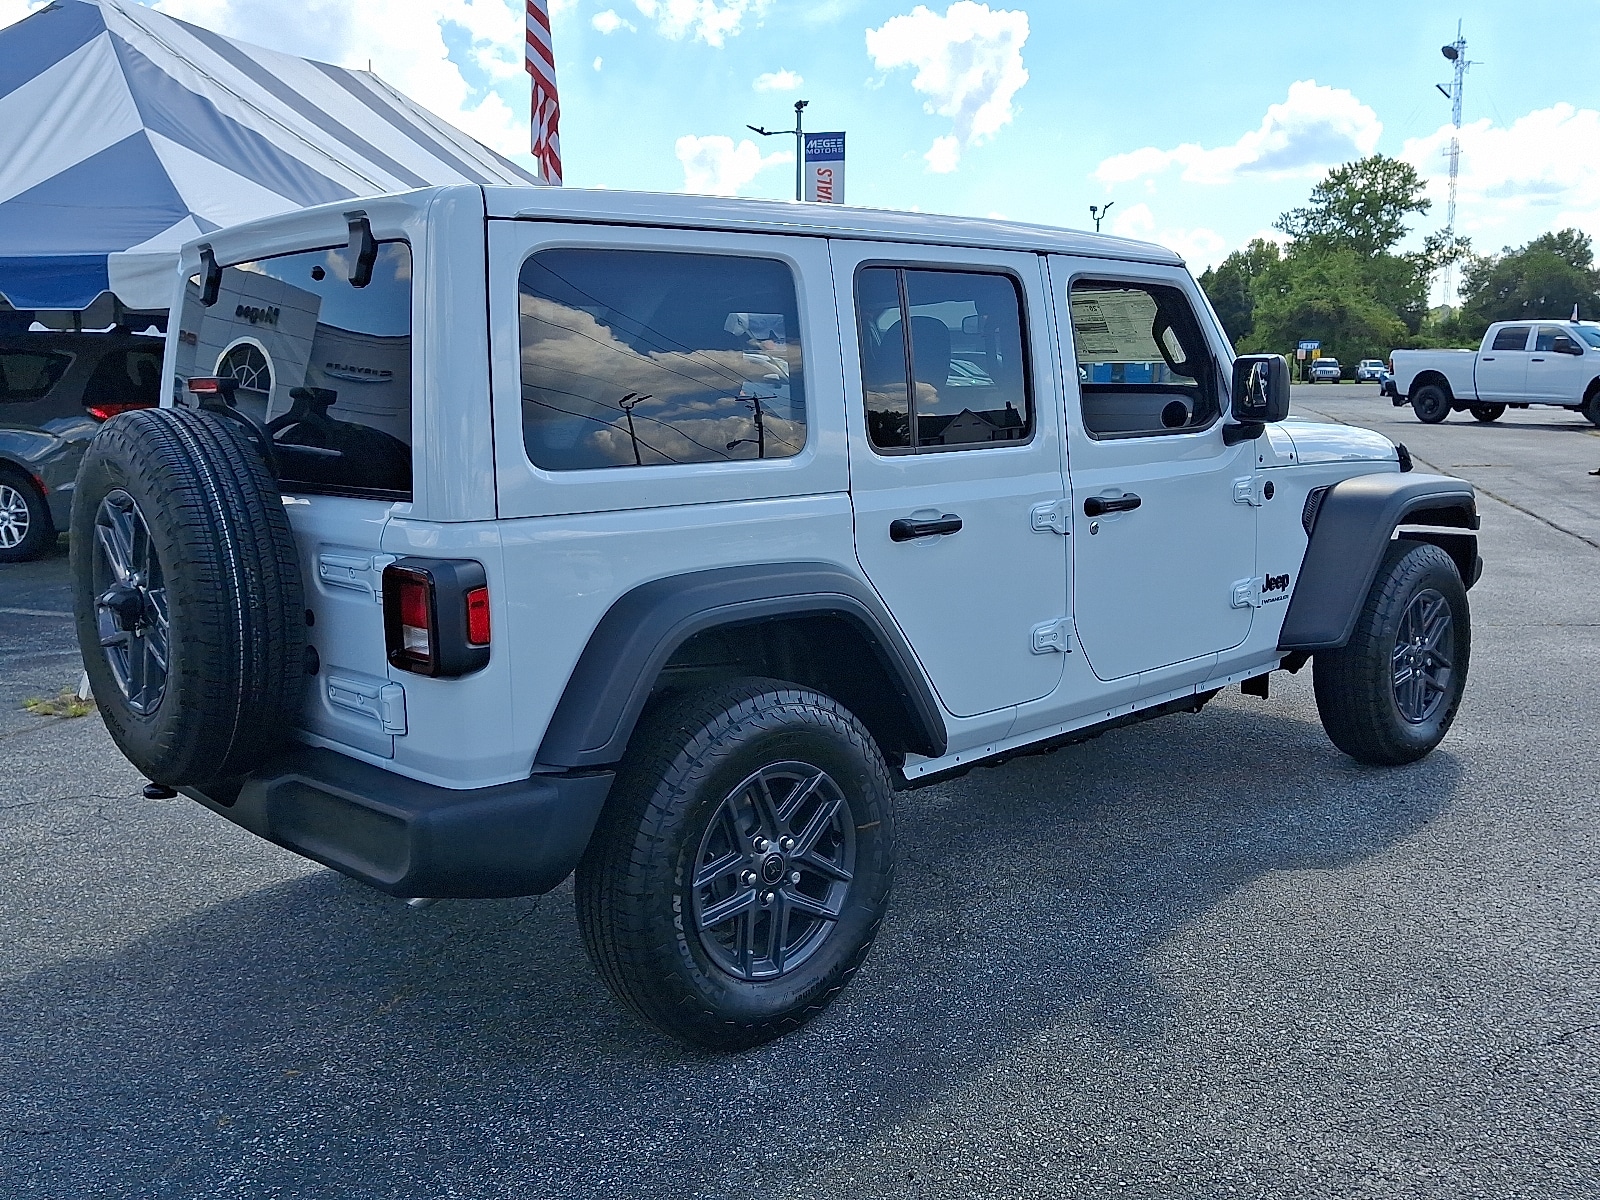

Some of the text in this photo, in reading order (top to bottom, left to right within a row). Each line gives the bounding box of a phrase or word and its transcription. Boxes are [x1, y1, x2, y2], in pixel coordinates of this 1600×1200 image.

[806, 138, 843, 149] MEGEE
[806, 147, 843, 155] MOTORS
[816, 168, 833, 203] IALS
[1262, 573, 1290, 593] Jeep
[672, 894, 714, 995] ROADIAN
